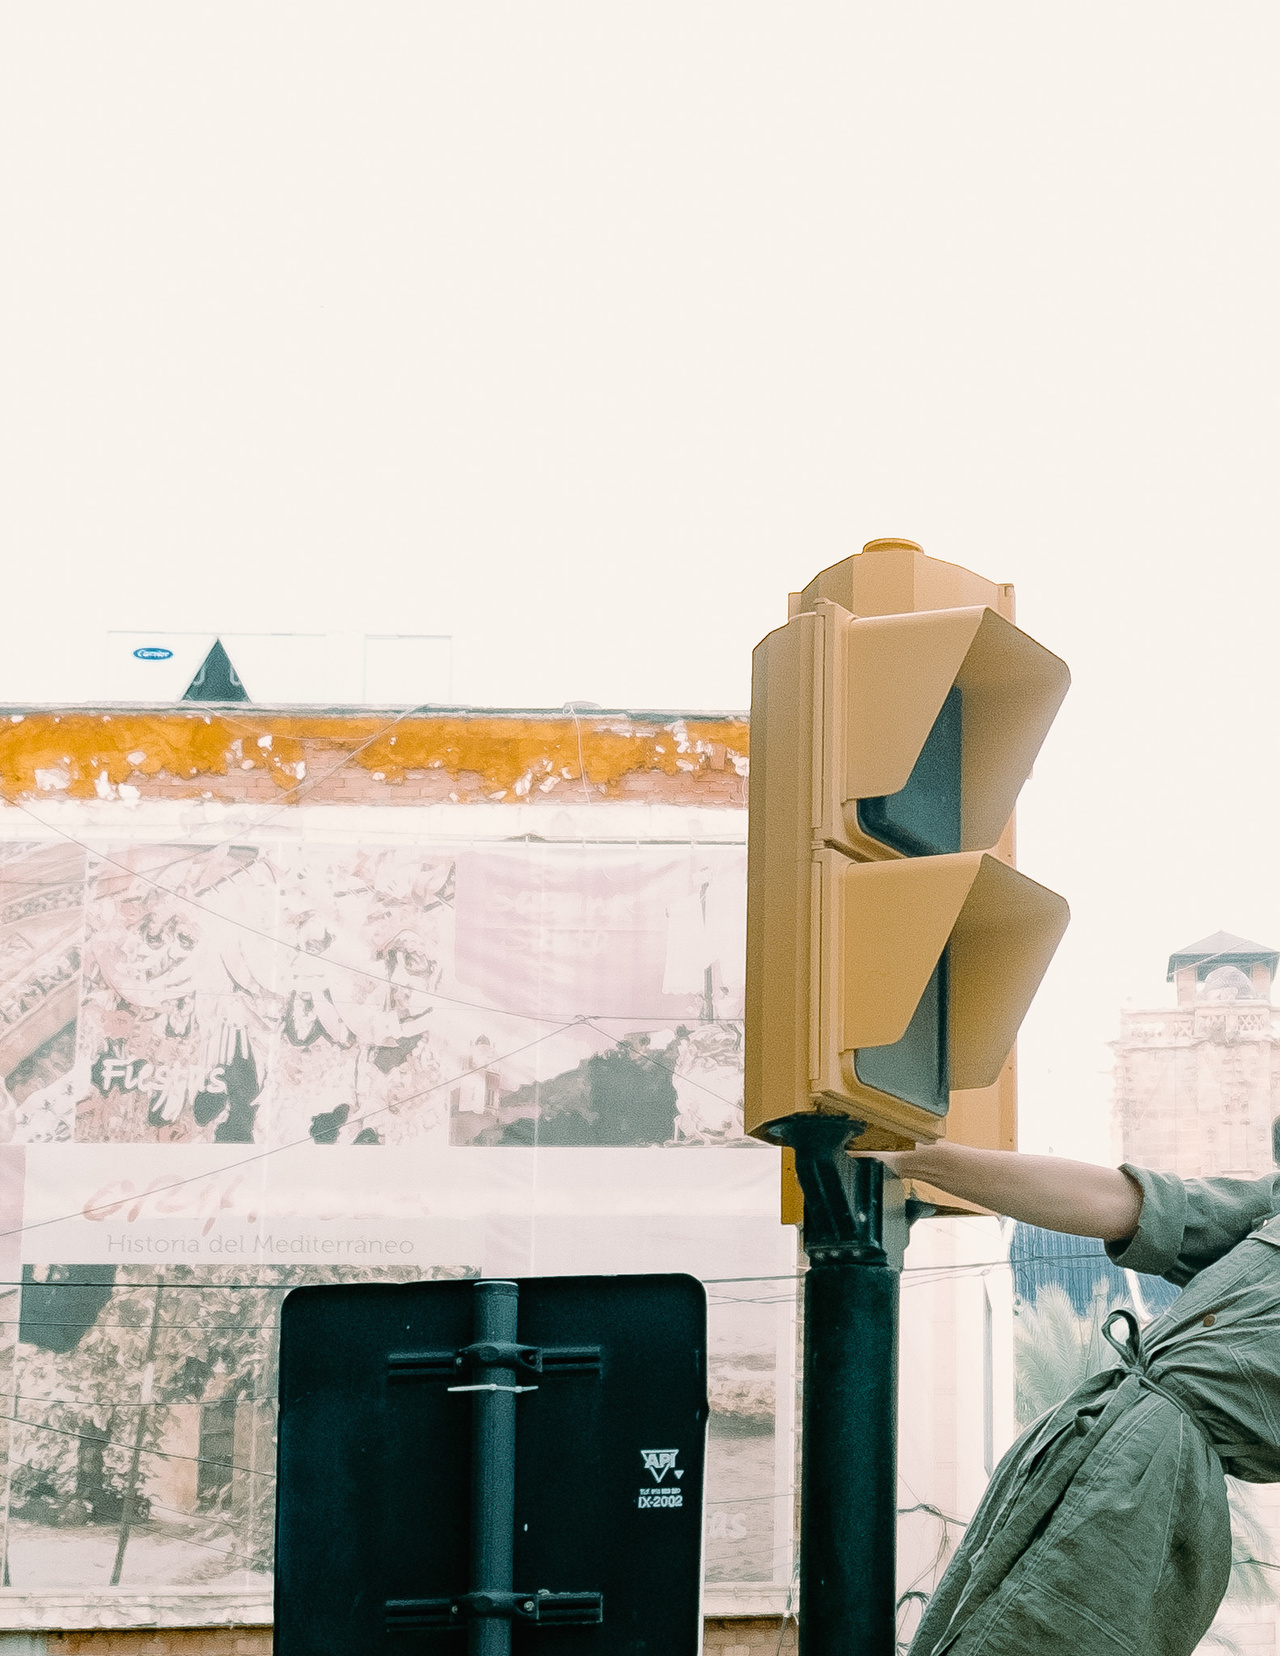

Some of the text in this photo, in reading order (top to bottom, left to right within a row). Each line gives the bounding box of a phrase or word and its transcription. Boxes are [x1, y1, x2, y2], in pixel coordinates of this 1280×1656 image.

[107, 1233, 415, 1254] Historia del Mediterráneo
[644, 1453, 676, 1468] API
[638, 1495, 683, 1508] IX-2002
